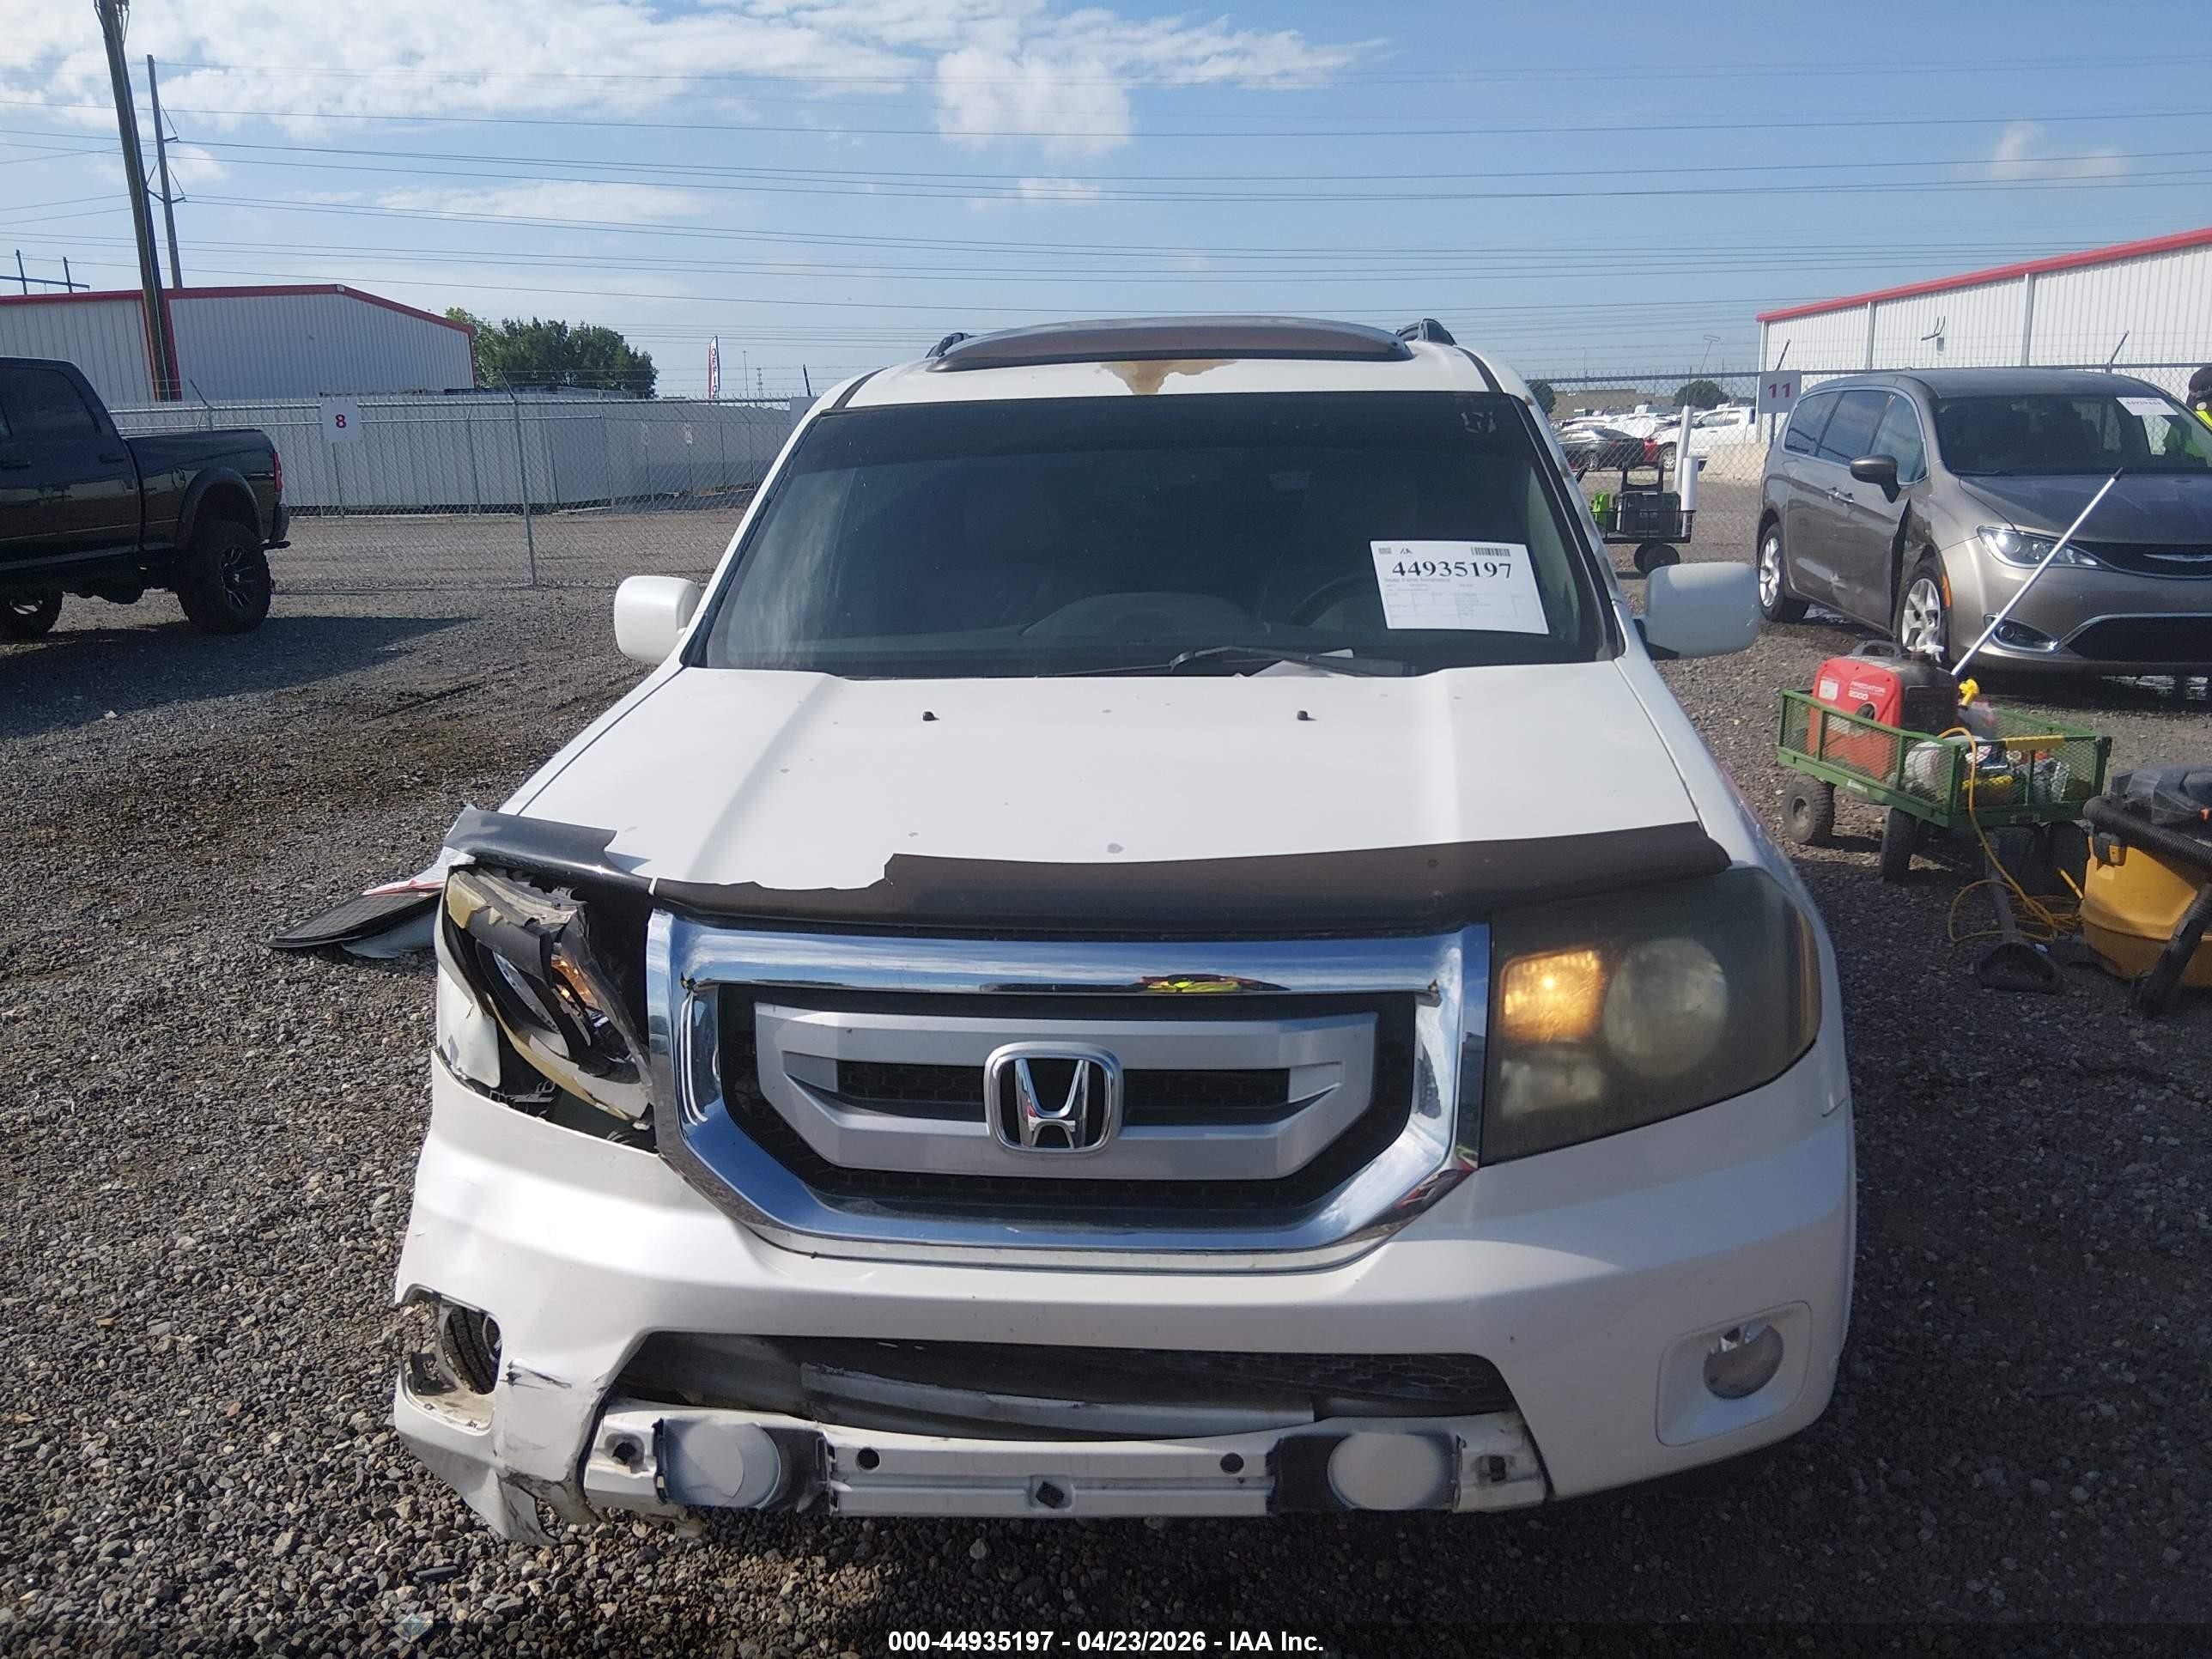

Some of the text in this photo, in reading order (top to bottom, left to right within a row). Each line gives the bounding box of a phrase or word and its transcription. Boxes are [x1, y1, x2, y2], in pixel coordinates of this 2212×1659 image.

[1768, 382, 1790, 398] 11
[335, 414, 347, 428] 8
[1392, 561, 1512, 580] 44935197
